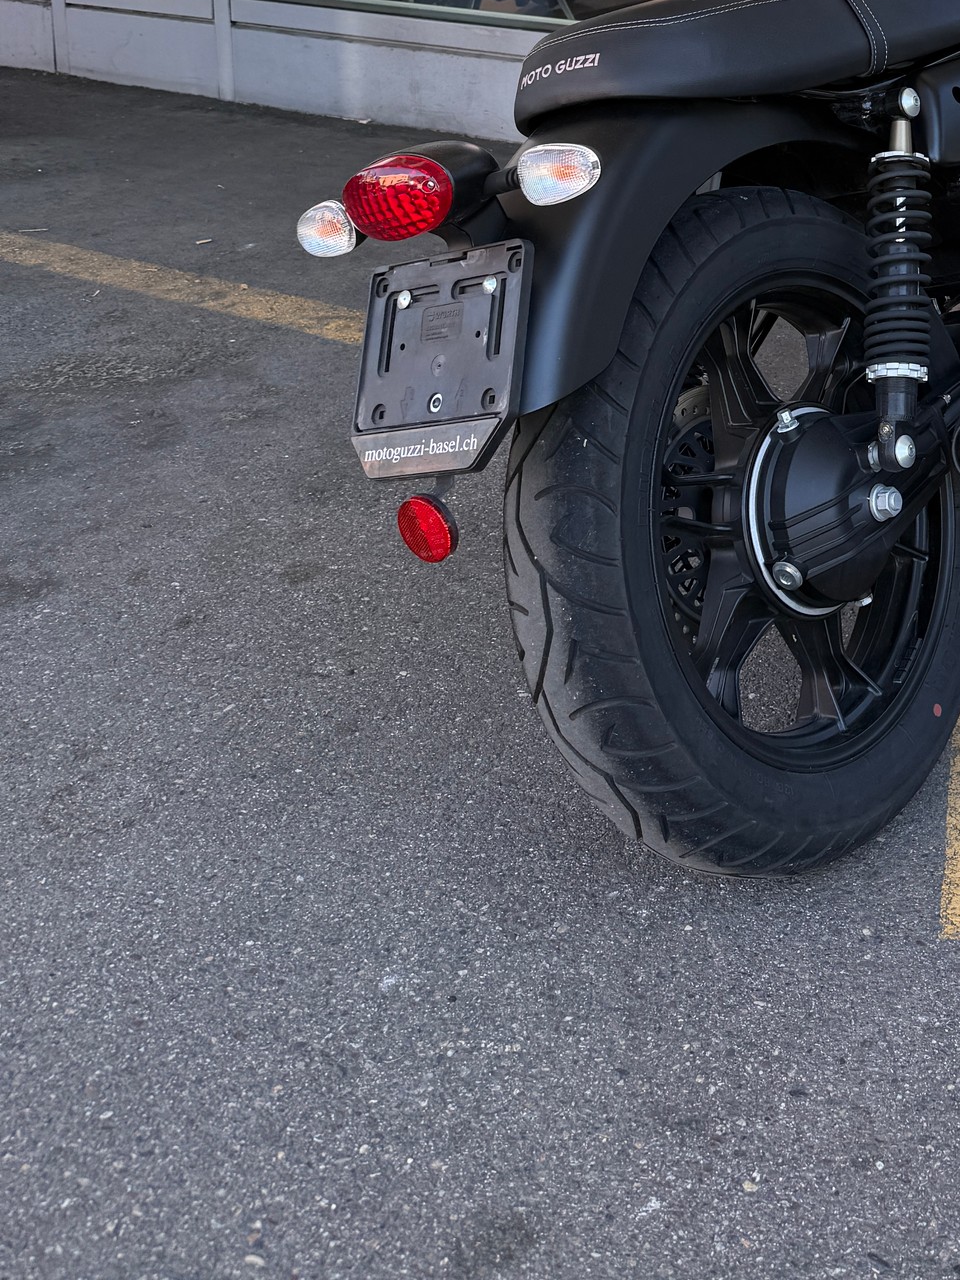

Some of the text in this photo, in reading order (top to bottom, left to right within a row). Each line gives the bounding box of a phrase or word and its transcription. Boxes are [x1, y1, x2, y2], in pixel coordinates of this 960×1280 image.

[520, 52, 601, 90] MOTO GUZZI
[364, 433, 478, 463] motoguzzi-basel.ch
